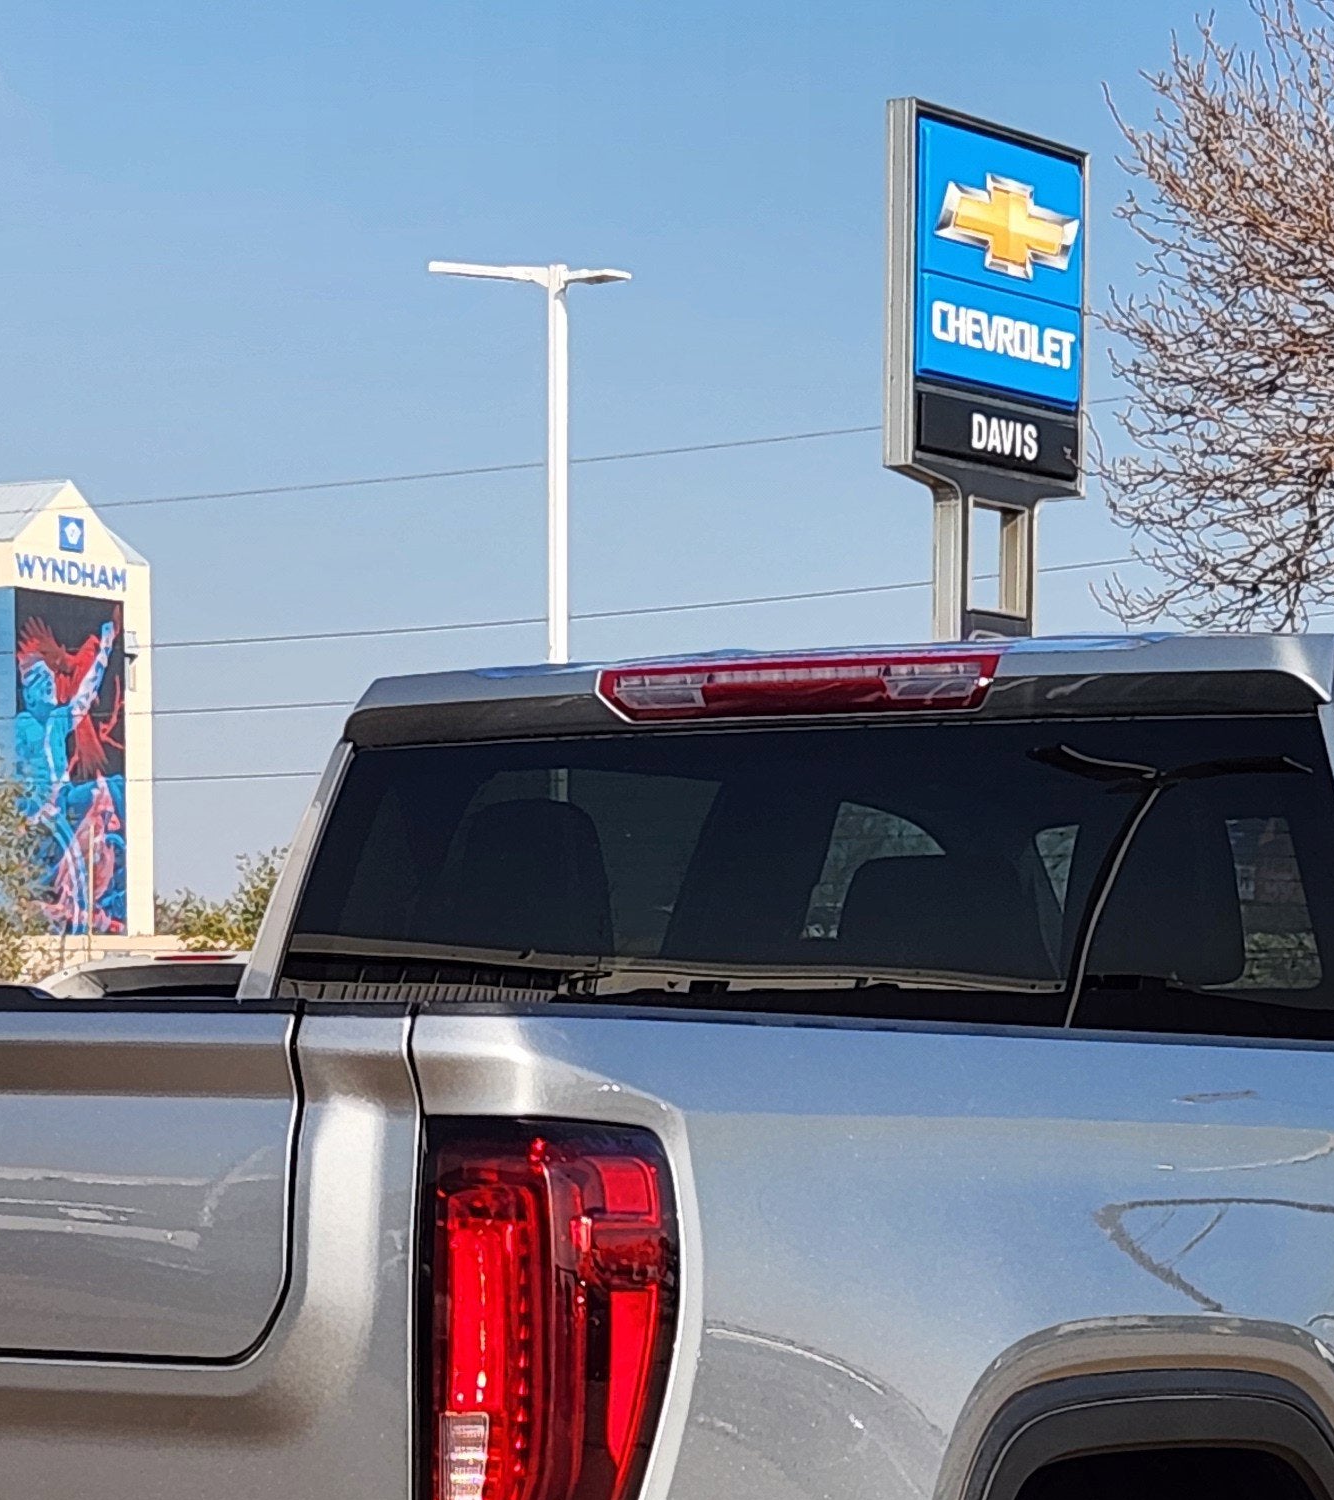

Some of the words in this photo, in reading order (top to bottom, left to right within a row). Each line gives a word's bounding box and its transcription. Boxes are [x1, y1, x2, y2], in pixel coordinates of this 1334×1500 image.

[931, 300, 1076, 371] CHEVROLET
[970, 413, 1039, 461] DAVIS
[15, 552, 128, 592] WYNDHAM
